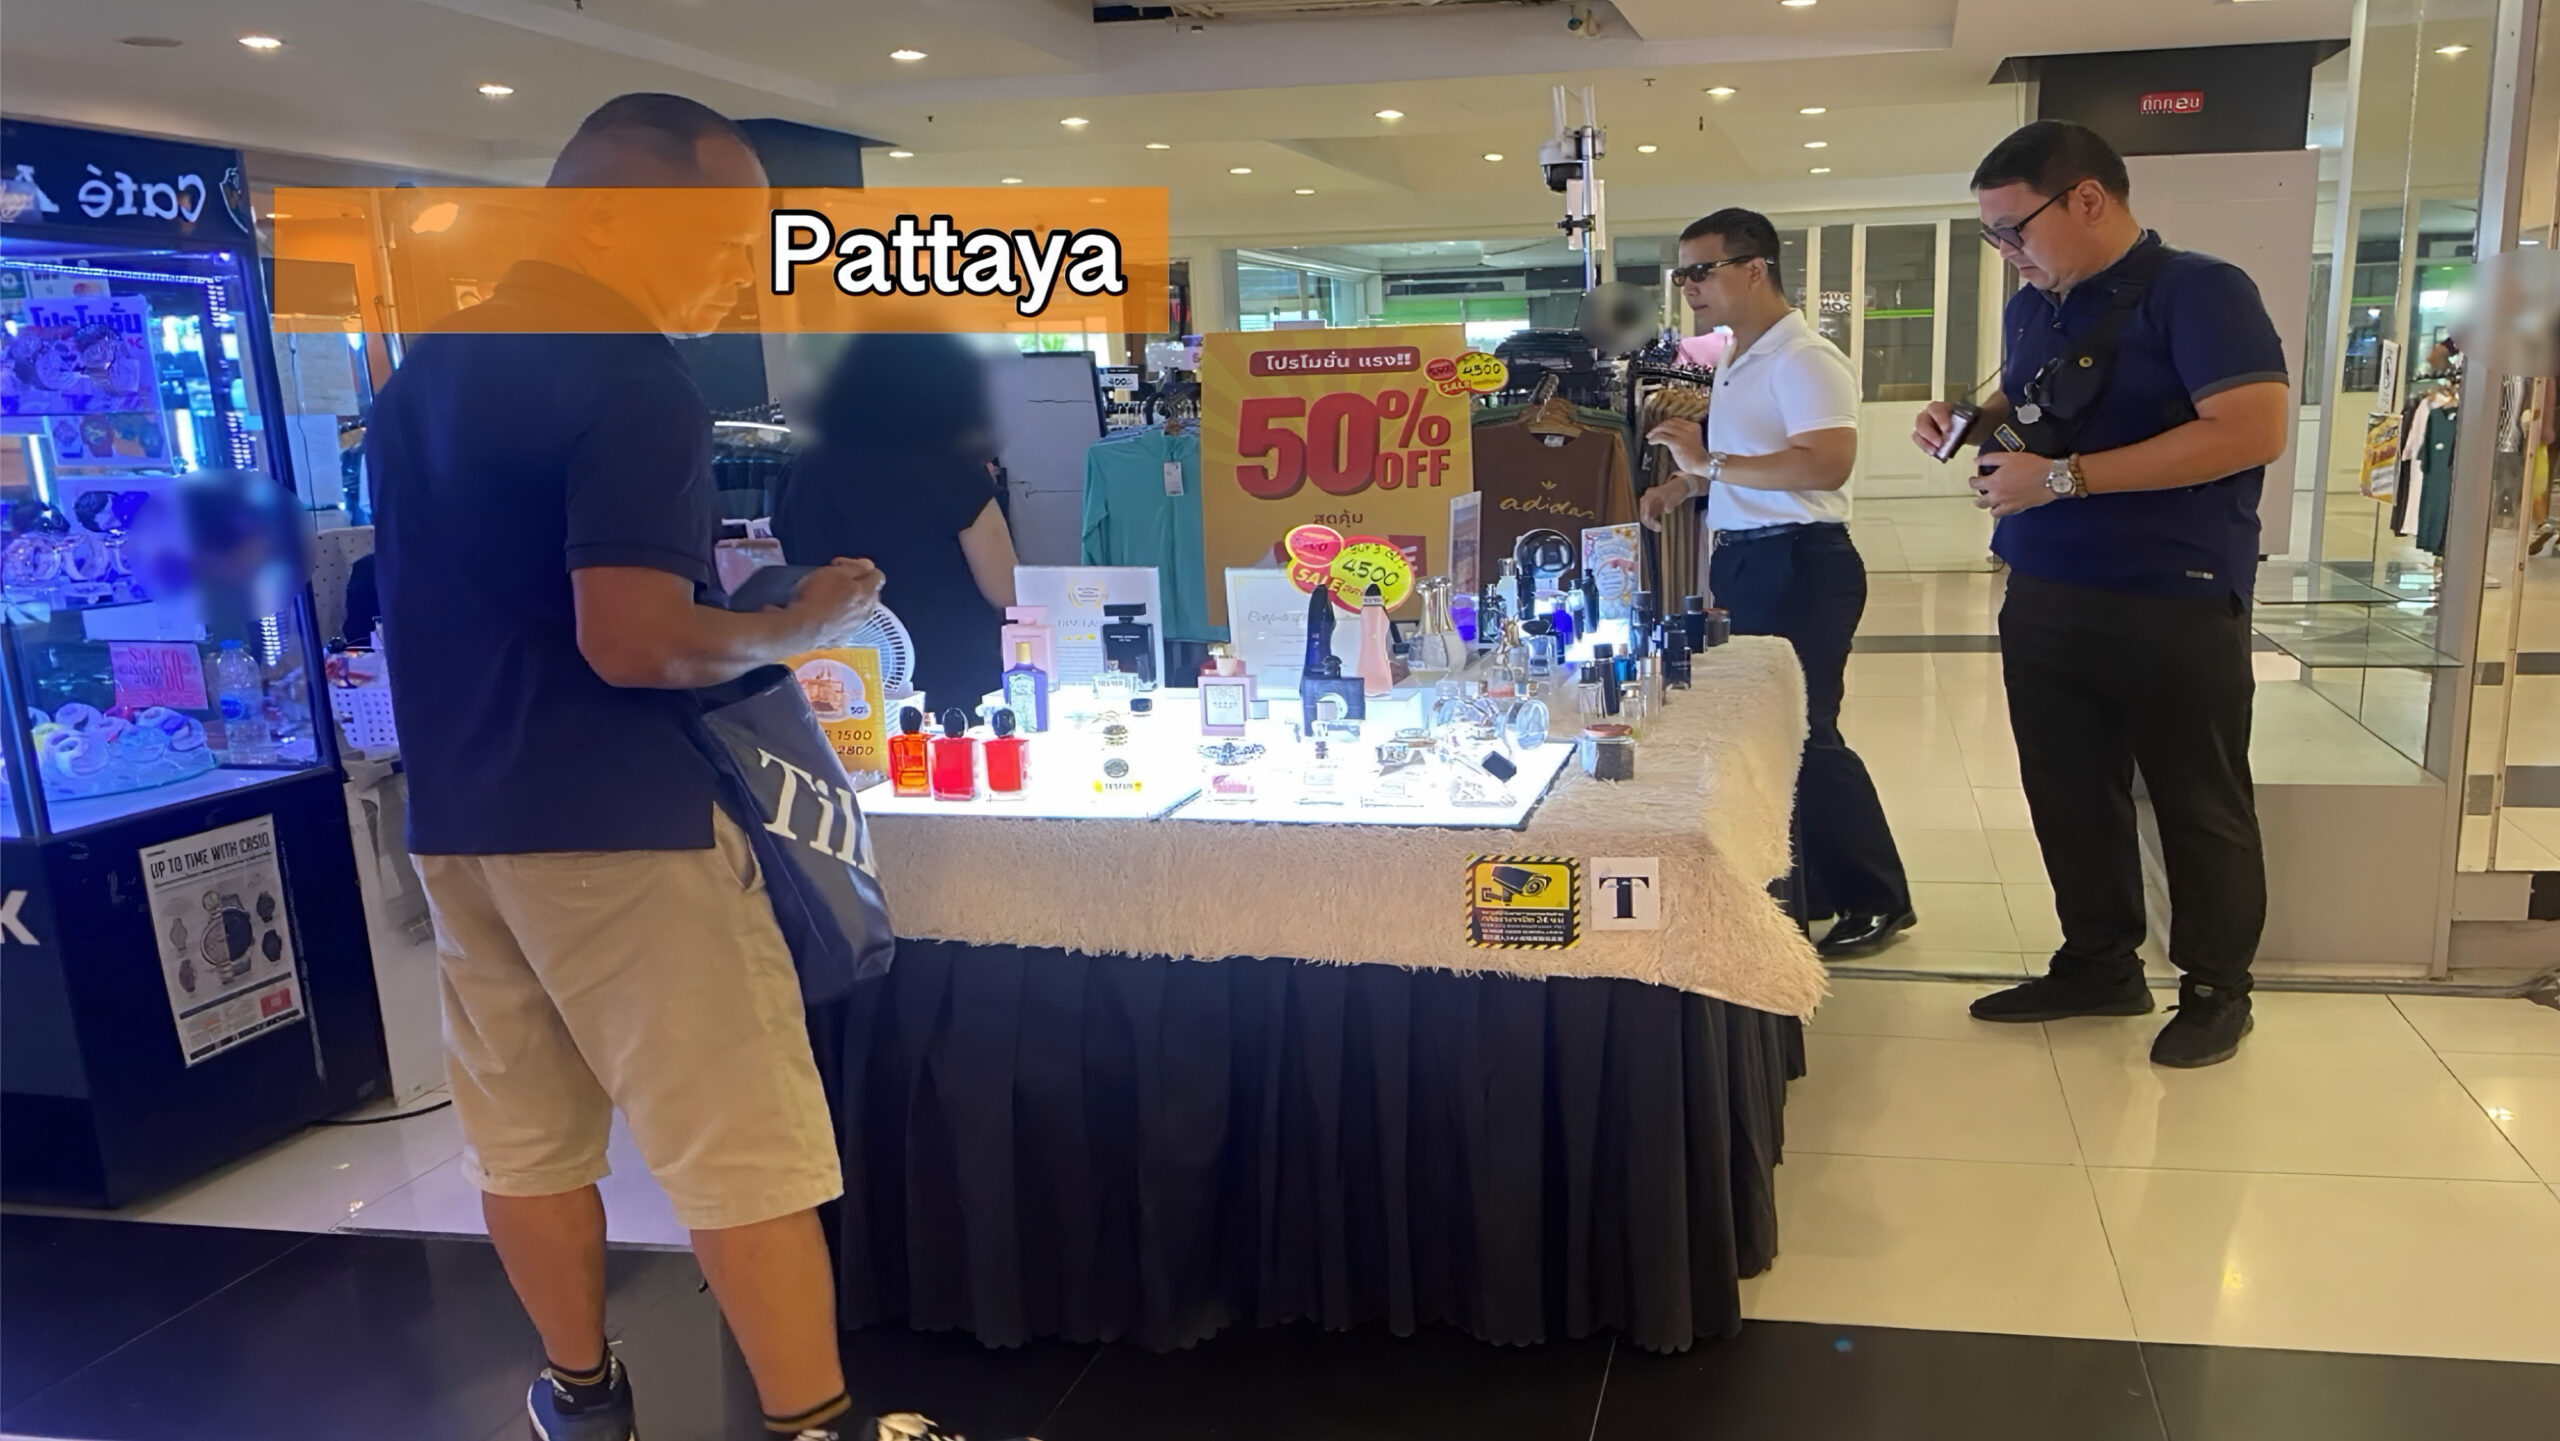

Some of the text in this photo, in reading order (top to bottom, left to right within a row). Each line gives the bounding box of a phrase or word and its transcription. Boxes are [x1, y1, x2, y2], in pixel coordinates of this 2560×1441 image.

[1266, 351, 1411, 371] โปรโมชั่น แรง!!
[1236, 388, 1451, 500] 50%
[1374, 449, 1450, 490] OFF
[1499, 495, 1596, 520] adidas
[1295, 568, 1344, 592] SALE
[838, 730, 872, 740] 1500
[150, 861, 166, 879] UP
[168, 856, 183, 873] TO
[185, 849, 209, 869] TIME
[210, 841, 238, 861] WITH
[1598, 876, 1650, 919] T
